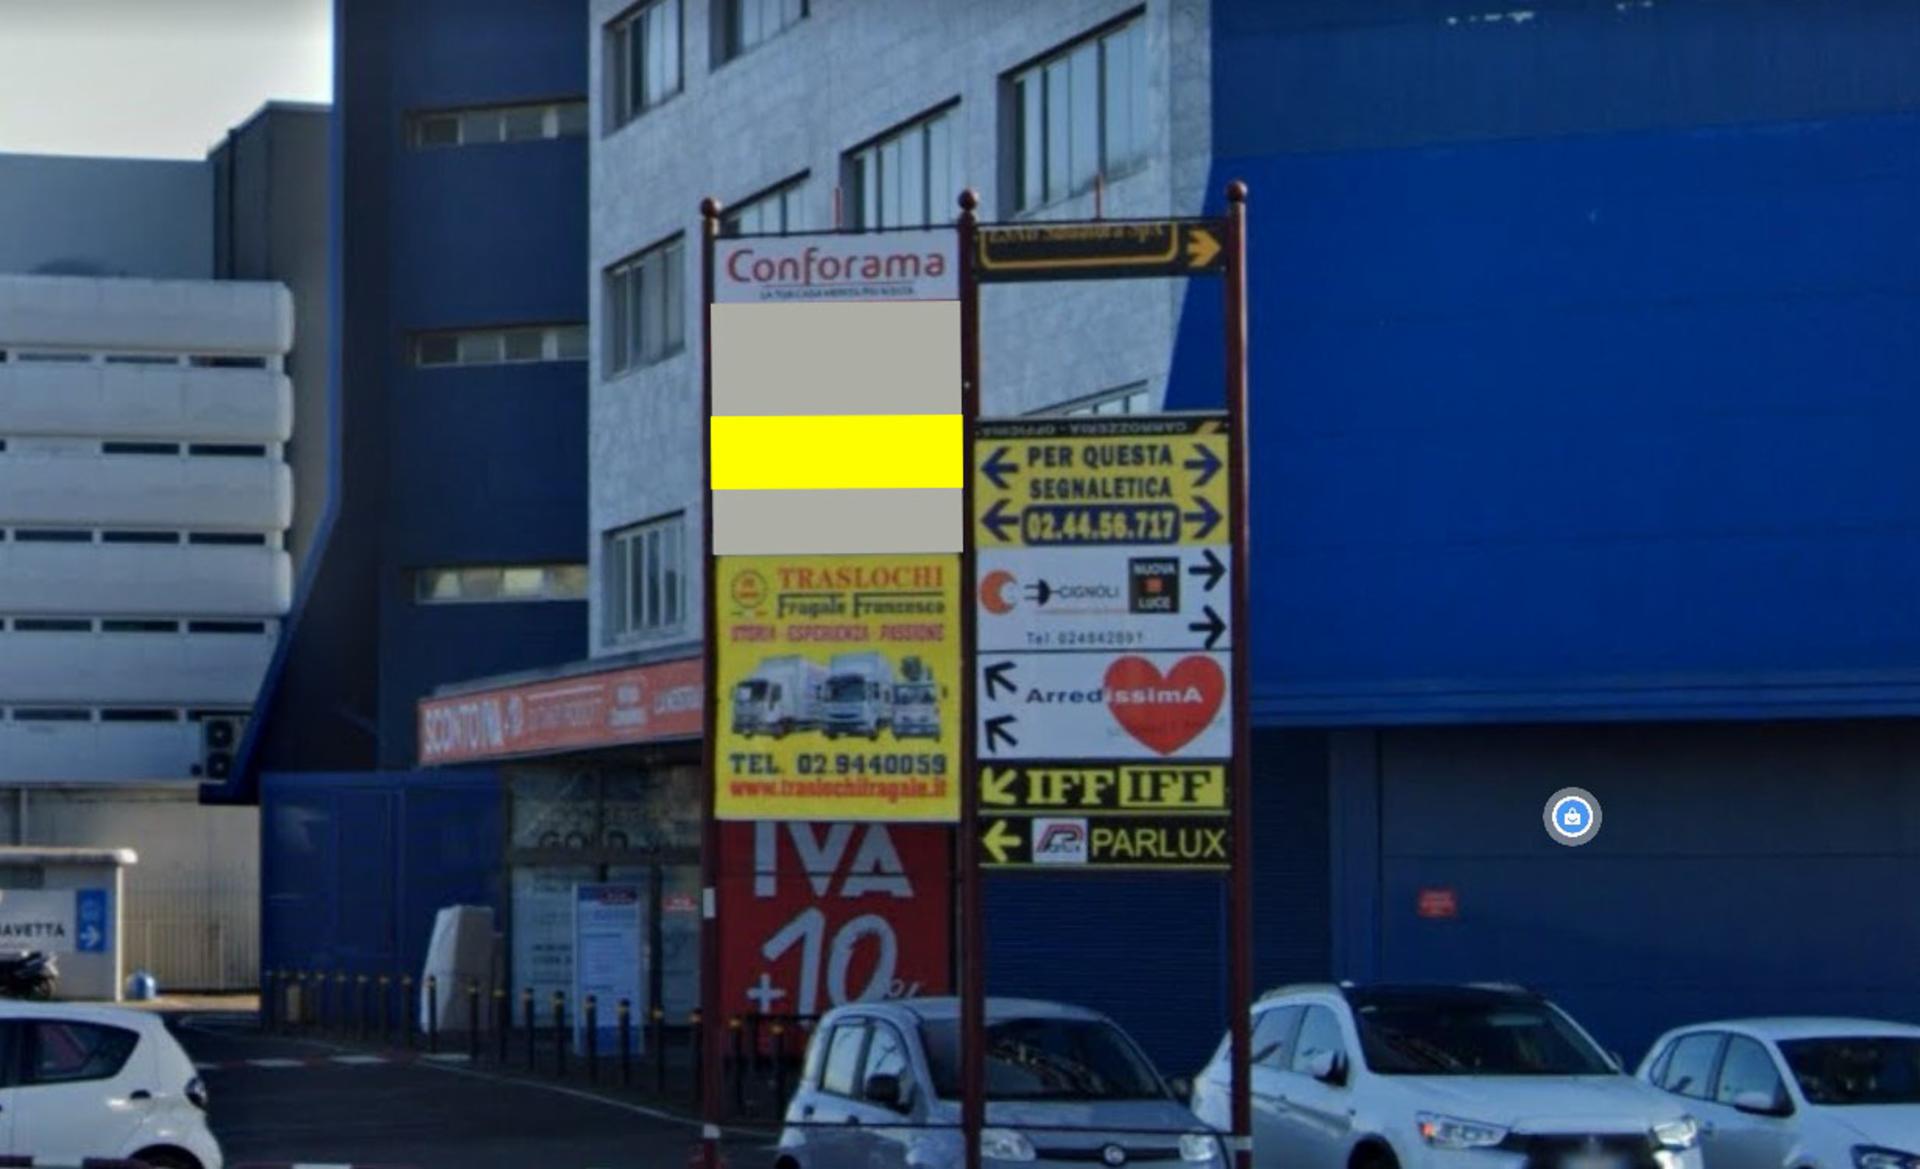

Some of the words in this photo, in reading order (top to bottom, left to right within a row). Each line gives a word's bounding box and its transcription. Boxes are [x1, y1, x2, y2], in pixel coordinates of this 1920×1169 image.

[727, 247, 946, 286] Conforama
[1027, 445, 1073, 468] PER
[1082, 444, 1174, 468] QUESTA
[1029, 477, 1173, 499] SEGNALETICA
[1027, 510, 1175, 539] 02.44.56.717
[778, 566, 944, 589] TRASLOCHI
[1133, 562, 1177, 576] NUOVA
[1058, 584, 1120, 600] CIGNOLI
[1137, 596, 1171, 609] LUCE
[777, 592, 847, 618] Fragale
[1026, 686, 1204, 704] ArredissimA
[1026, 769, 1114, 805] IFF
[1126, 769, 1212, 803] IFF
[1091, 828, 1226, 858] PARLUX
[754, 821, 915, 898] IVA
[0, 922, 65, 938] AVETTA
